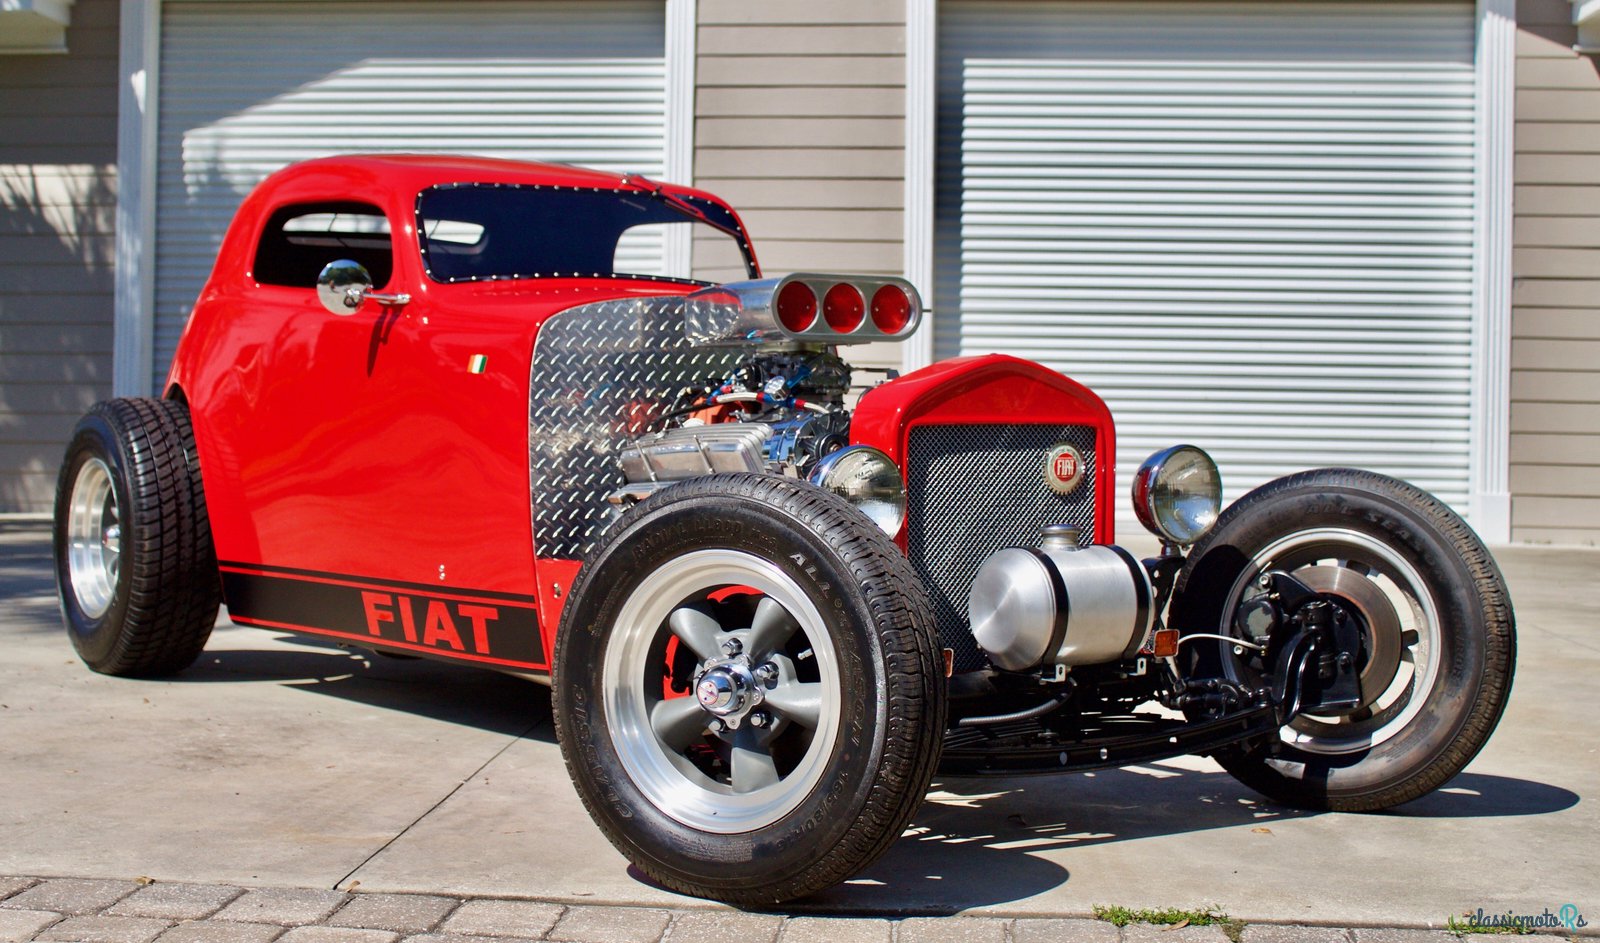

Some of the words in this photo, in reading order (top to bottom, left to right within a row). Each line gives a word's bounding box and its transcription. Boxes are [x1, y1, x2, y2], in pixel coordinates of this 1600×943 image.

[1057, 460, 1074, 475] FIAT
[789, 551, 832, 599] ALL
[361, 591, 499, 655] FIAT
[573, 684, 633, 819] CLASSIC
